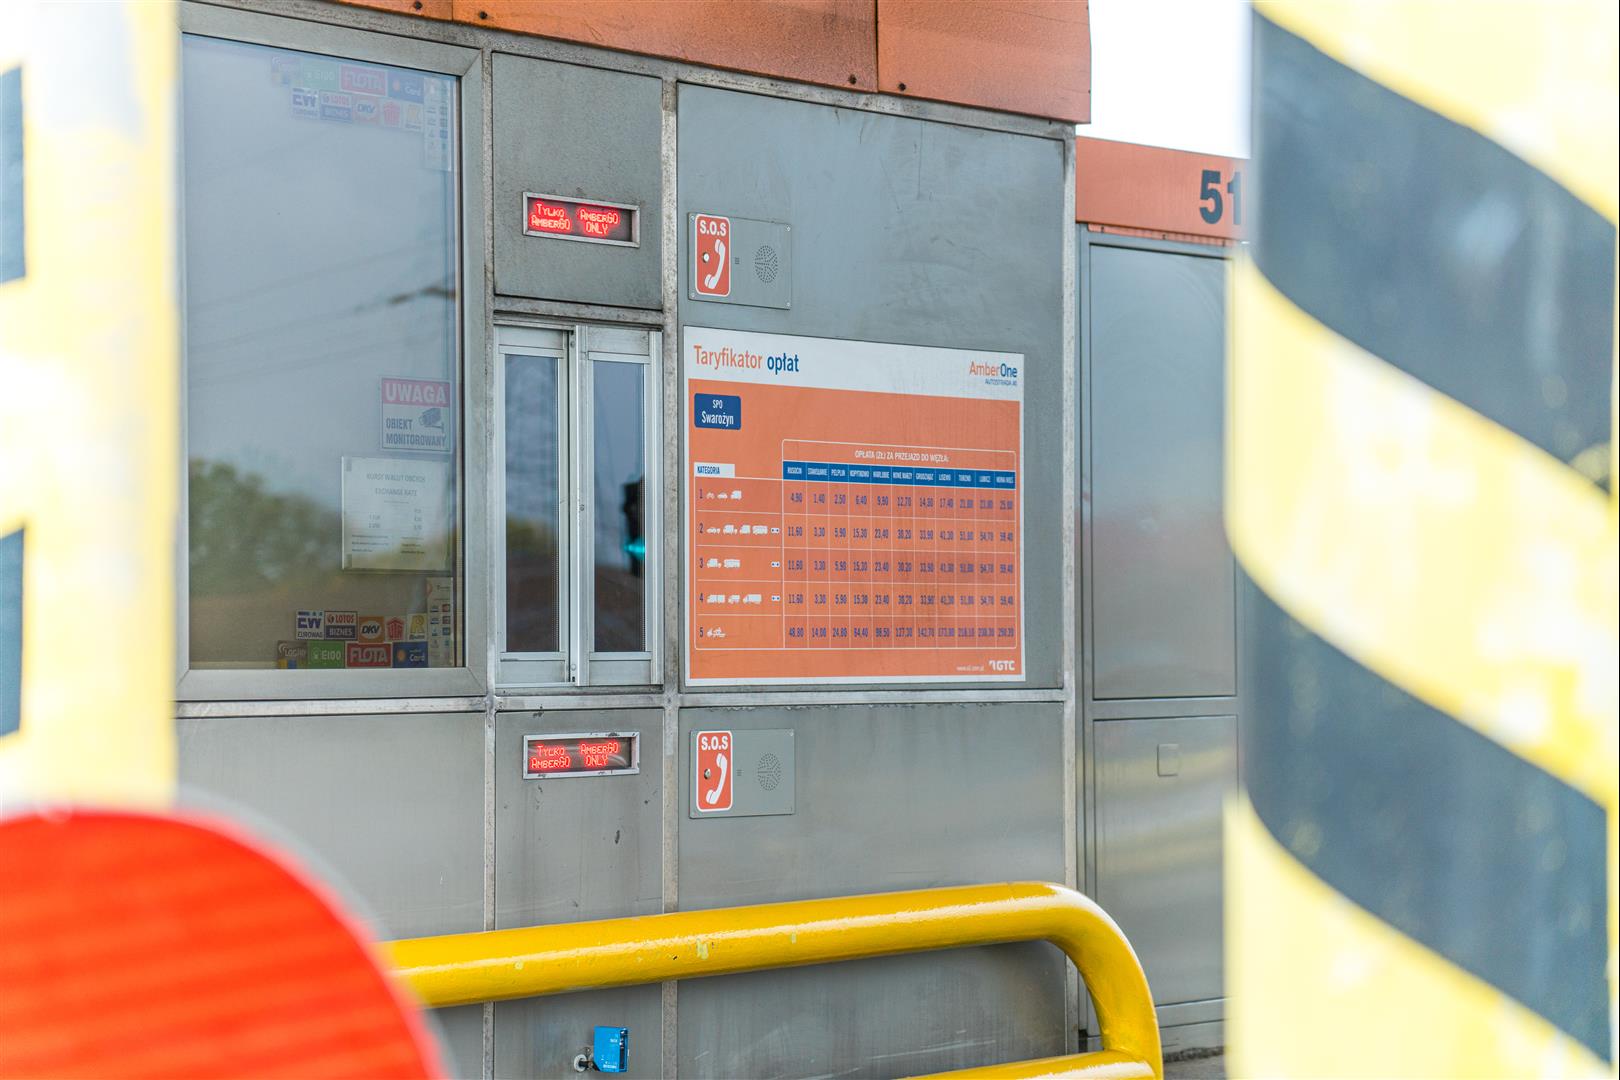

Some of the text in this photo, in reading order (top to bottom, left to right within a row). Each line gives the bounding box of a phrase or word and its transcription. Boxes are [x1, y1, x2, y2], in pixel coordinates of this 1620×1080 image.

[1199, 169, 1241, 224] 51
[586, 221, 608, 234] ONLY
[700, 220, 727, 237] S.O.S
[694, 345, 799, 375] Taryfikator opłat
[970, 361, 1018, 378] AmberOne
[385, 382, 448, 404] UWAGA
[712, 399, 723, 409] SPO
[386, 417, 413, 430] OBIEKT
[701, 411, 734, 427] Swarożyn
[386, 433, 447, 447] MONITOROWANY
[887, 452, 895, 460] ZA
[697, 465, 720, 475] KATEGORIA
[699, 488, 704, 499] 1
[699, 523, 704, 534] 2
[699, 557, 704, 568] 3
[699, 592, 704, 603] 4
[298, 618, 321, 629] EW
[335, 614, 354, 624] LOTOS
[361, 626, 380, 635] DKV
[699, 626, 704, 638] 5
[351, 648, 387, 663] FLOTA
[410, 653, 425, 662] Card
[701, 736, 728, 751] S.O.S
[586, 755, 608, 767] ONLY
